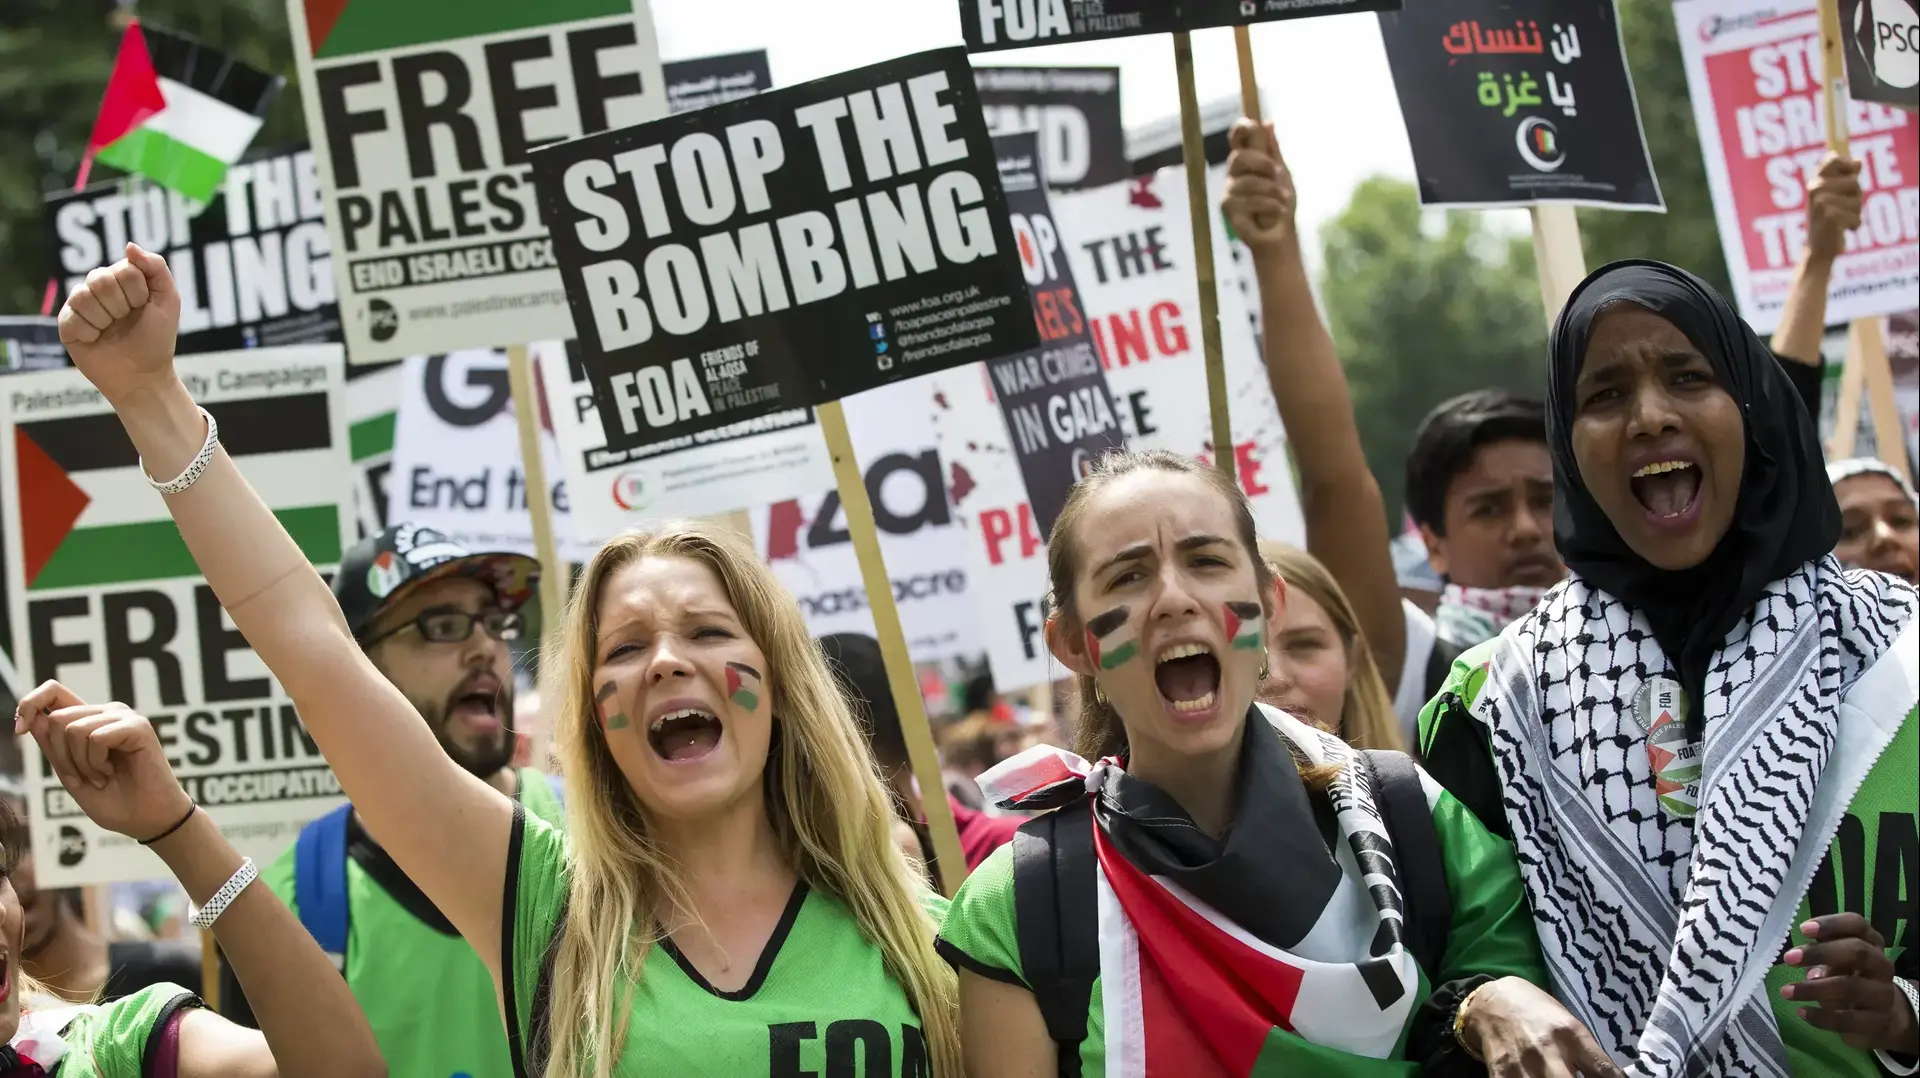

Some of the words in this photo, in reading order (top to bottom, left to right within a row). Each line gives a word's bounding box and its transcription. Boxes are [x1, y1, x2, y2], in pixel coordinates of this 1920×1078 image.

[1550, 23, 1582, 64] لن
[1748, 35, 1823, 98] STO
[315, 22, 643, 189] FREE
[1477, 71, 1542, 117] غزة
[1545, 71, 1577, 117] يا
[563, 119, 785, 252] STOP
[795, 70, 969, 193] THE
[1765, 134, 1903, 210] STTE
[224, 151, 325, 237] THE
[336, 173, 550, 253] PALEST
[1009, 213, 1060, 286] OP
[1752, 187, 1919, 269] TEOR
[354, 258, 404, 290] END
[408, 245, 505, 283] ISRAELI
[582, 170, 997, 352] BOMBING
[1082, 226, 1175, 284] THE
[889, 284, 981, 317] www.foa.org.uk
[894, 295, 1011, 333] /foapeaceinpalestine
[896, 315, 995, 348] @friendsofalaqsa
[217, 365, 328, 396] Campaign
[610, 357, 712, 435] FOA
[700, 343, 745, 368] FRIENDS
[744, 340, 760, 357] OF
[708, 376, 742, 397] PEACE
[994, 355, 1045, 397] WAR
[1042, 343, 1098, 385] CRIMES
[713, 396, 727, 413] IN
[727, 382, 781, 410] PALESTINE
[1011, 402, 1049, 455] IN
[1047, 385, 1116, 445] GAZA
[409, 466, 492, 511] End
[505, 468, 572, 513] te
[1633, 683, 1651, 717] PALESTINE
[1659, 691, 1672, 709] FOA
[1651, 728, 1665, 745] FREE
[1677, 747, 1697, 761] FOA
[203, 770, 342, 805] OCCUPATIO
[1685, 784, 1699, 798] FO
